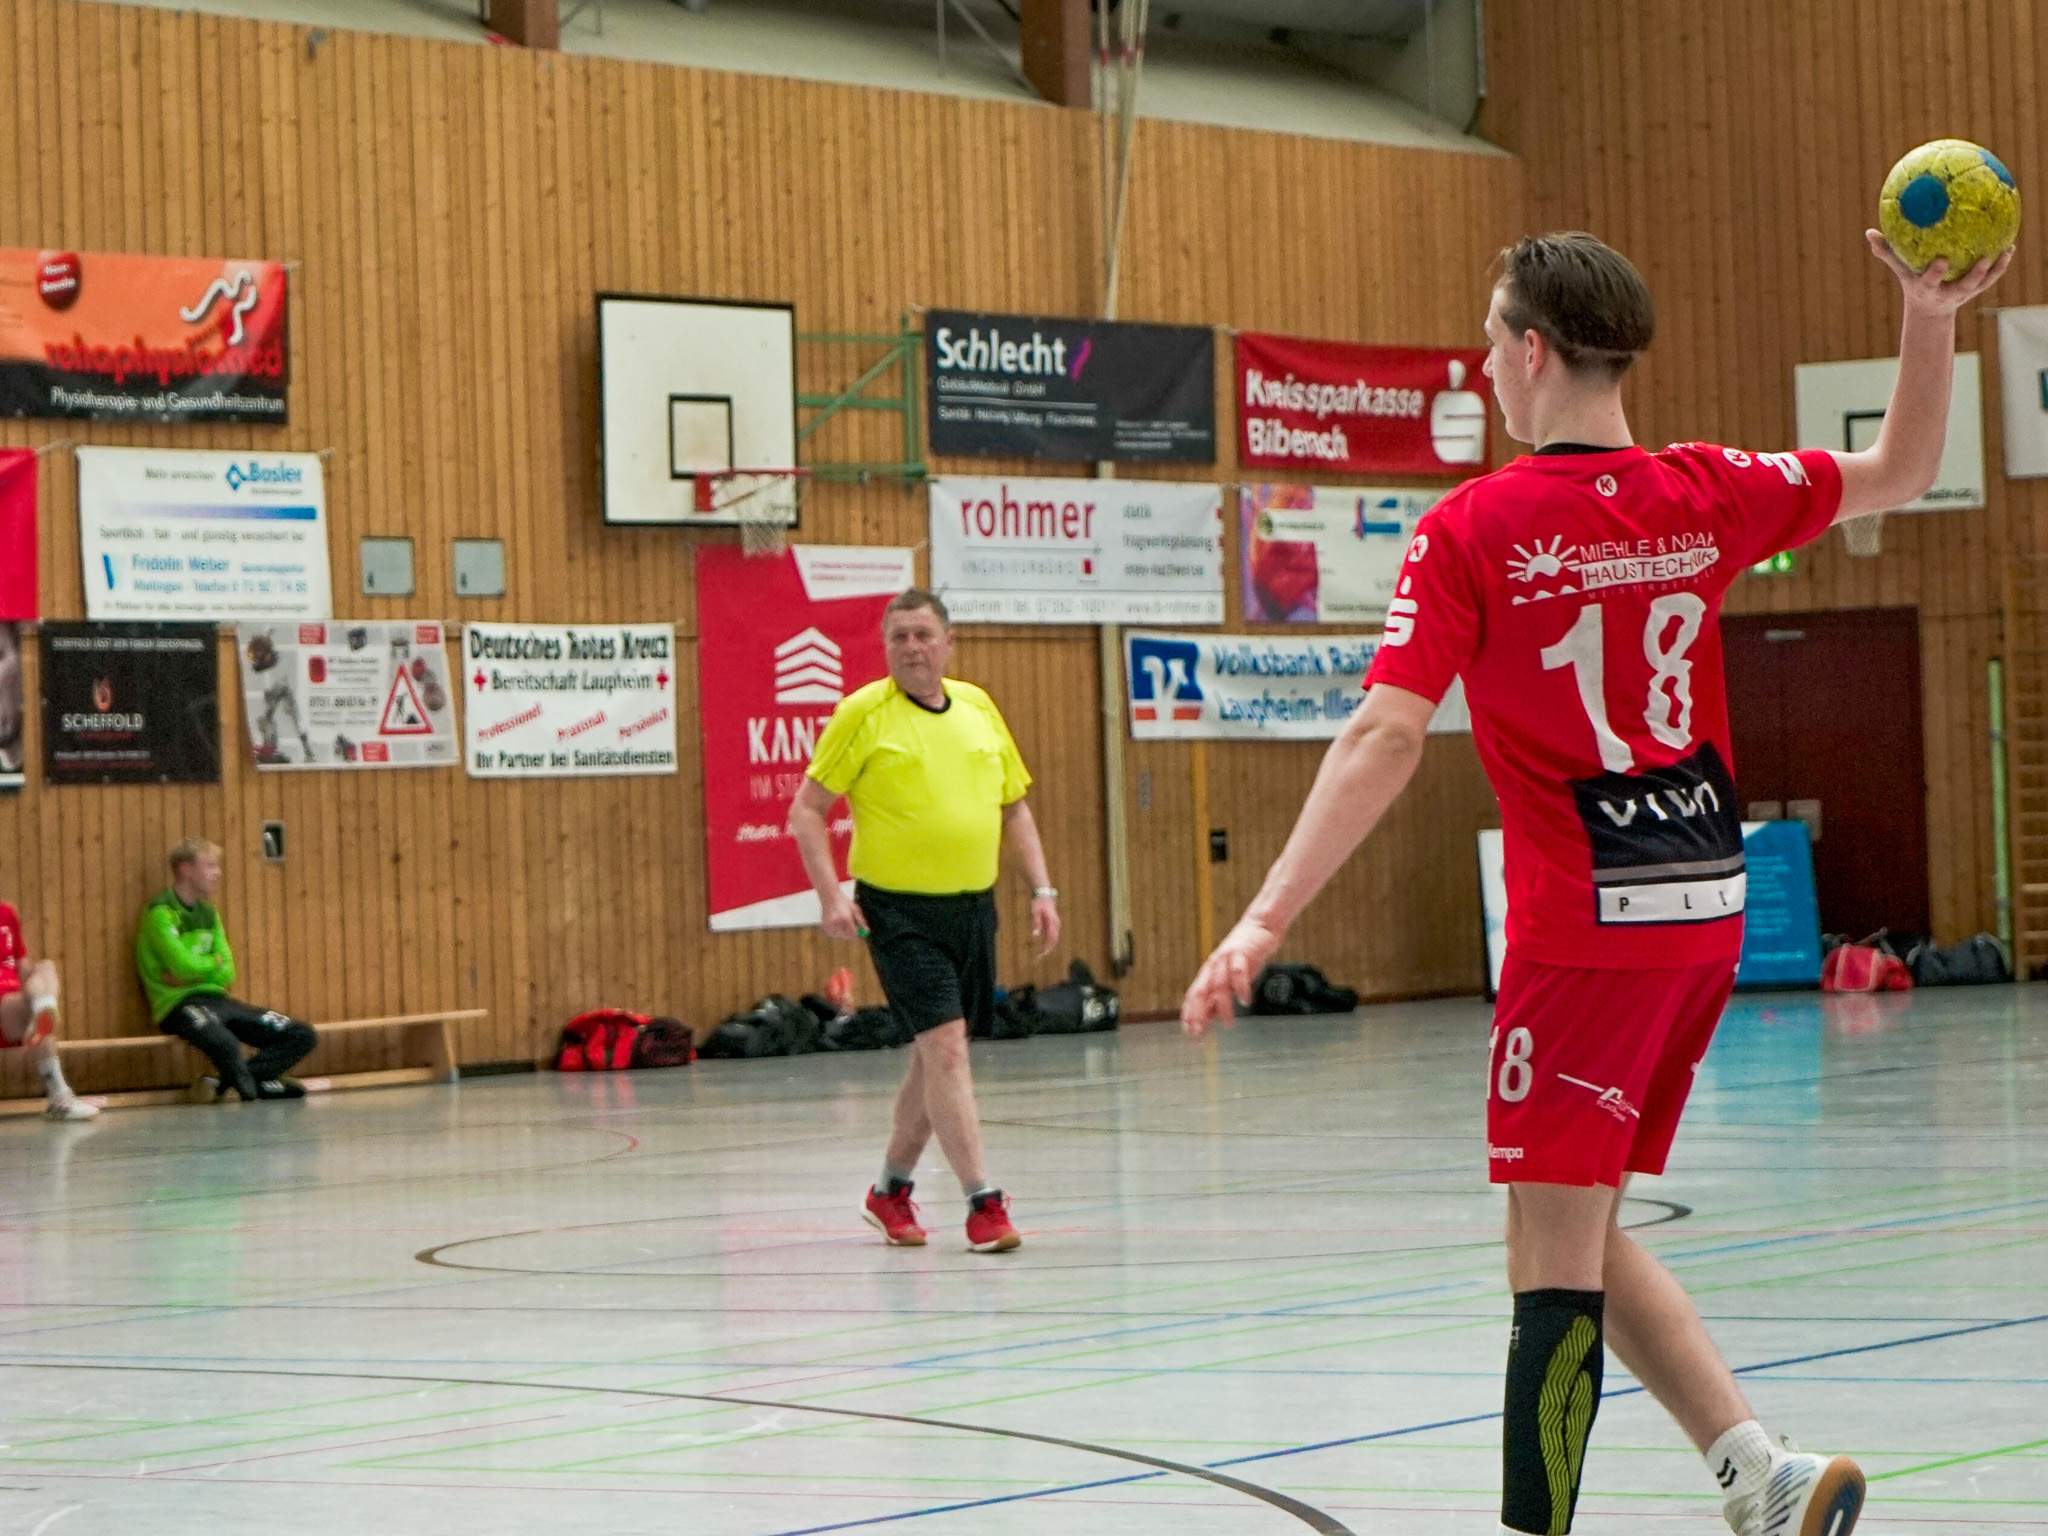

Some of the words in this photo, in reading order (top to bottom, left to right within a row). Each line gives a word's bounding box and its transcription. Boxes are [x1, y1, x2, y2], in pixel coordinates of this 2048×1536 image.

[936, 327, 1067, 376] Schlecht
[143, 392, 165, 409] und
[249, 460, 303, 482] Basler
[961, 484, 1095, 540] rohmer
[1580, 540, 1651, 563] MIEHLE
[1657, 537, 1667, 555] &
[1584, 551, 1717, 586] HAUSTECHNIK
[470, 629, 562, 660] Deutsches
[566, 630, 617, 660] Rotes
[620, 630, 669, 659] Kreuz
[1213, 643, 1326, 677] Volksbank
[491, 668, 578, 690] Bereitschaft
[581, 669, 651, 696] Laupheim
[1541, 592, 1706, 773] 18
[62, 713, 144, 732] SCHEFFOLD
[748, 716, 831, 764] KAN
[475, 751, 494, 768] Ihr
[499, 750, 546, 768] Partner
